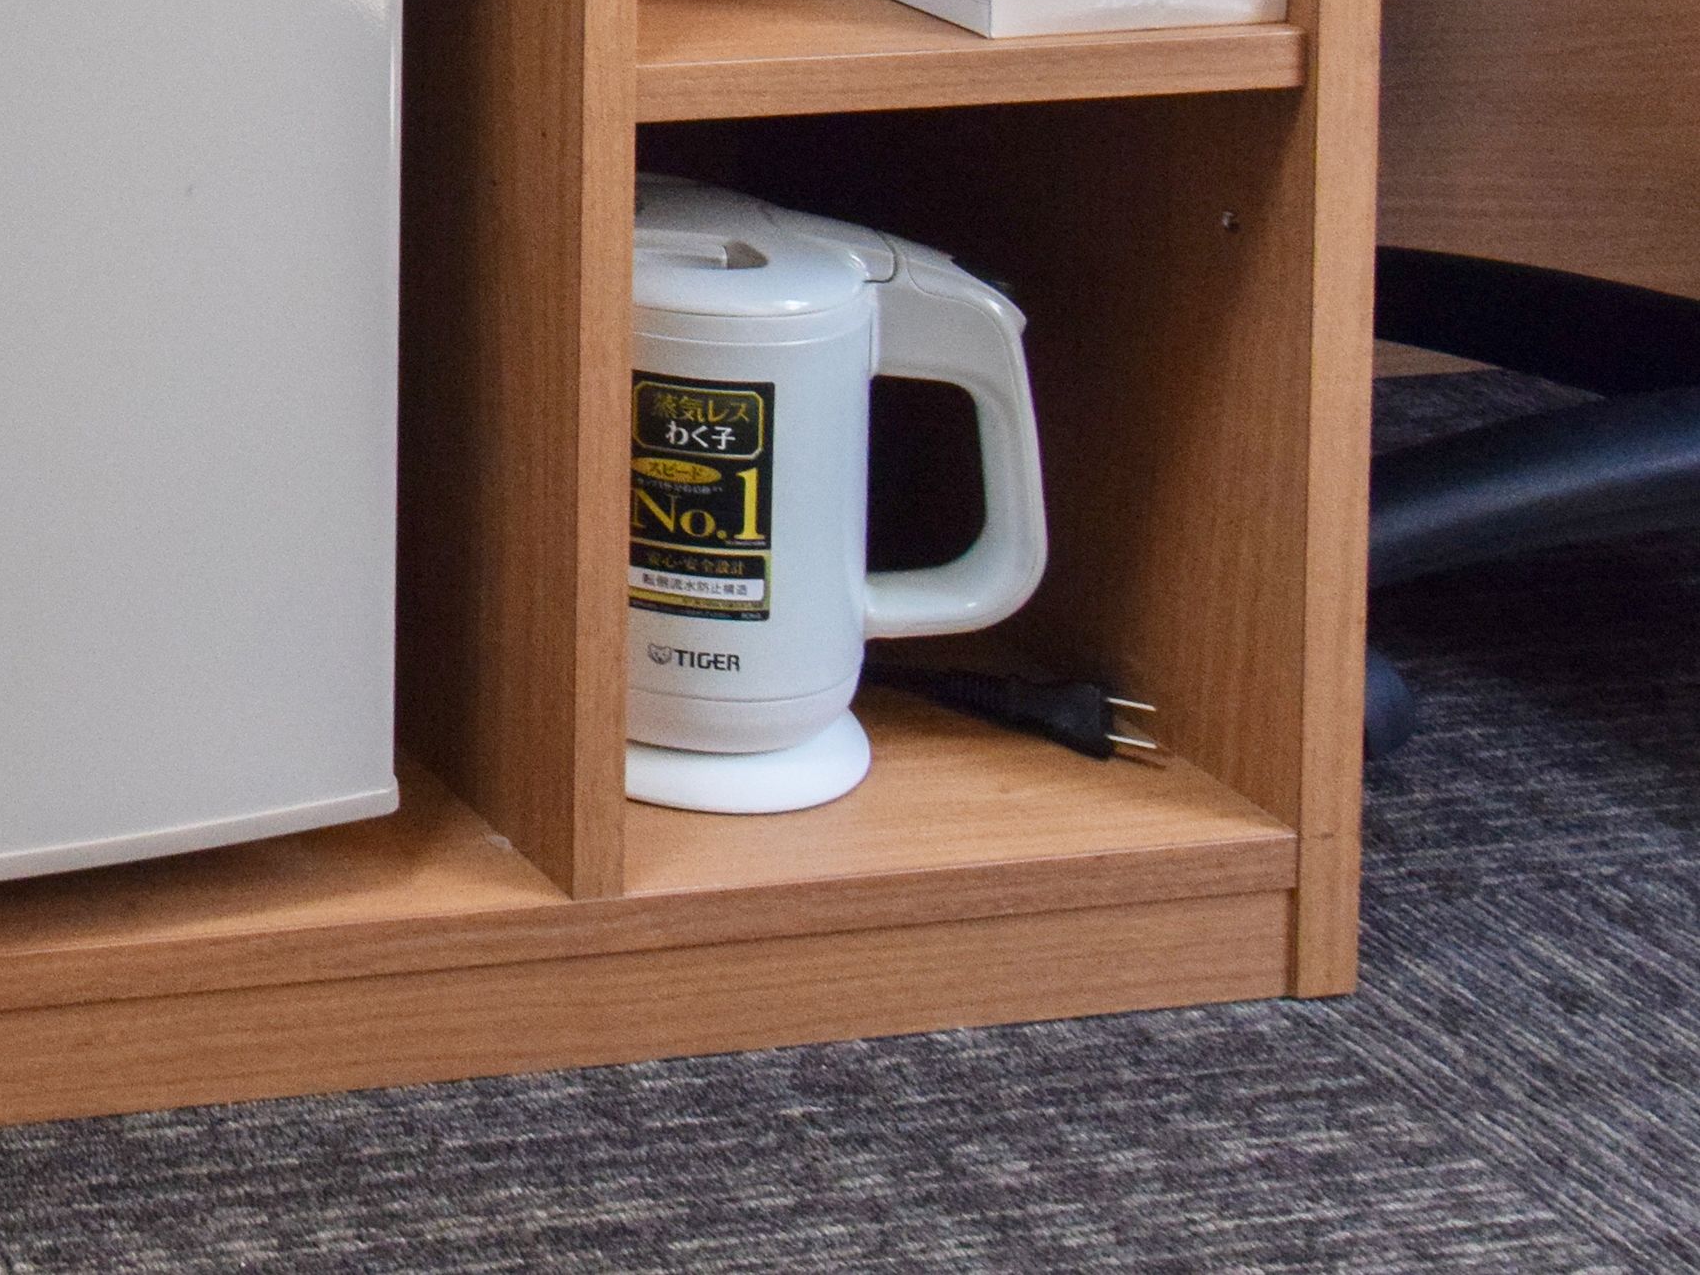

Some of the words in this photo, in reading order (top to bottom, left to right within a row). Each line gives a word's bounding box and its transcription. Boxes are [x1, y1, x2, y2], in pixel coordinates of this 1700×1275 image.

[652, 392, 750, 423] 蒸気レス
[665, 420, 736, 450] わく子
[674, 648, 741, 671] TIGER
